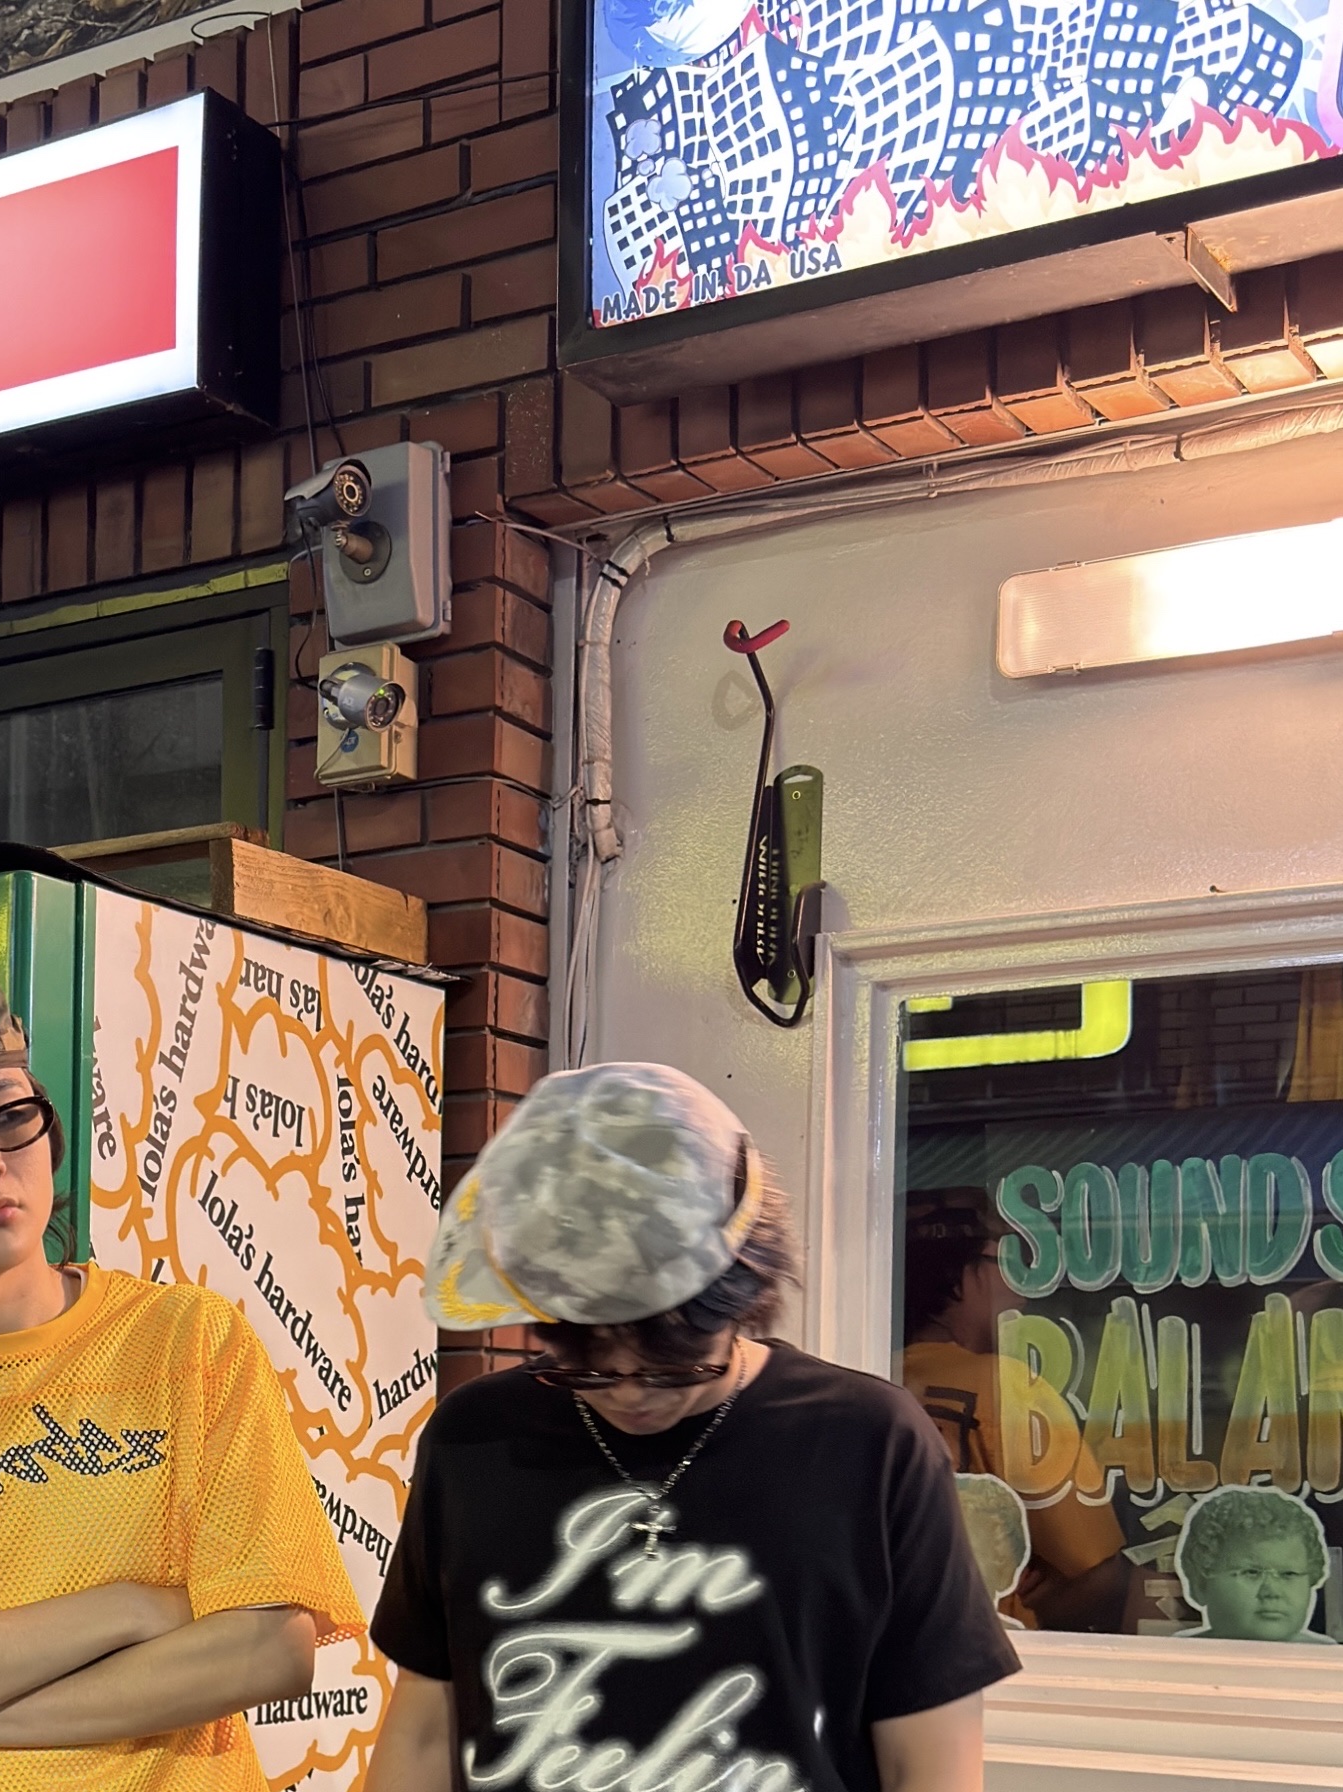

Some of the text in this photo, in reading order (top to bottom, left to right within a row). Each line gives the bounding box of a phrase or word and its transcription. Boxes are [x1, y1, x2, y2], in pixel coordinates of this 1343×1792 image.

[602, 243, 843, 325] MADE IN DA USA
[393, 1012, 442, 1115] hard
[336, 1073, 366, 1268] lola's har
[197, 1170, 352, 1412] lola's hardware
[311, 1475, 393, 1578] hardwa
